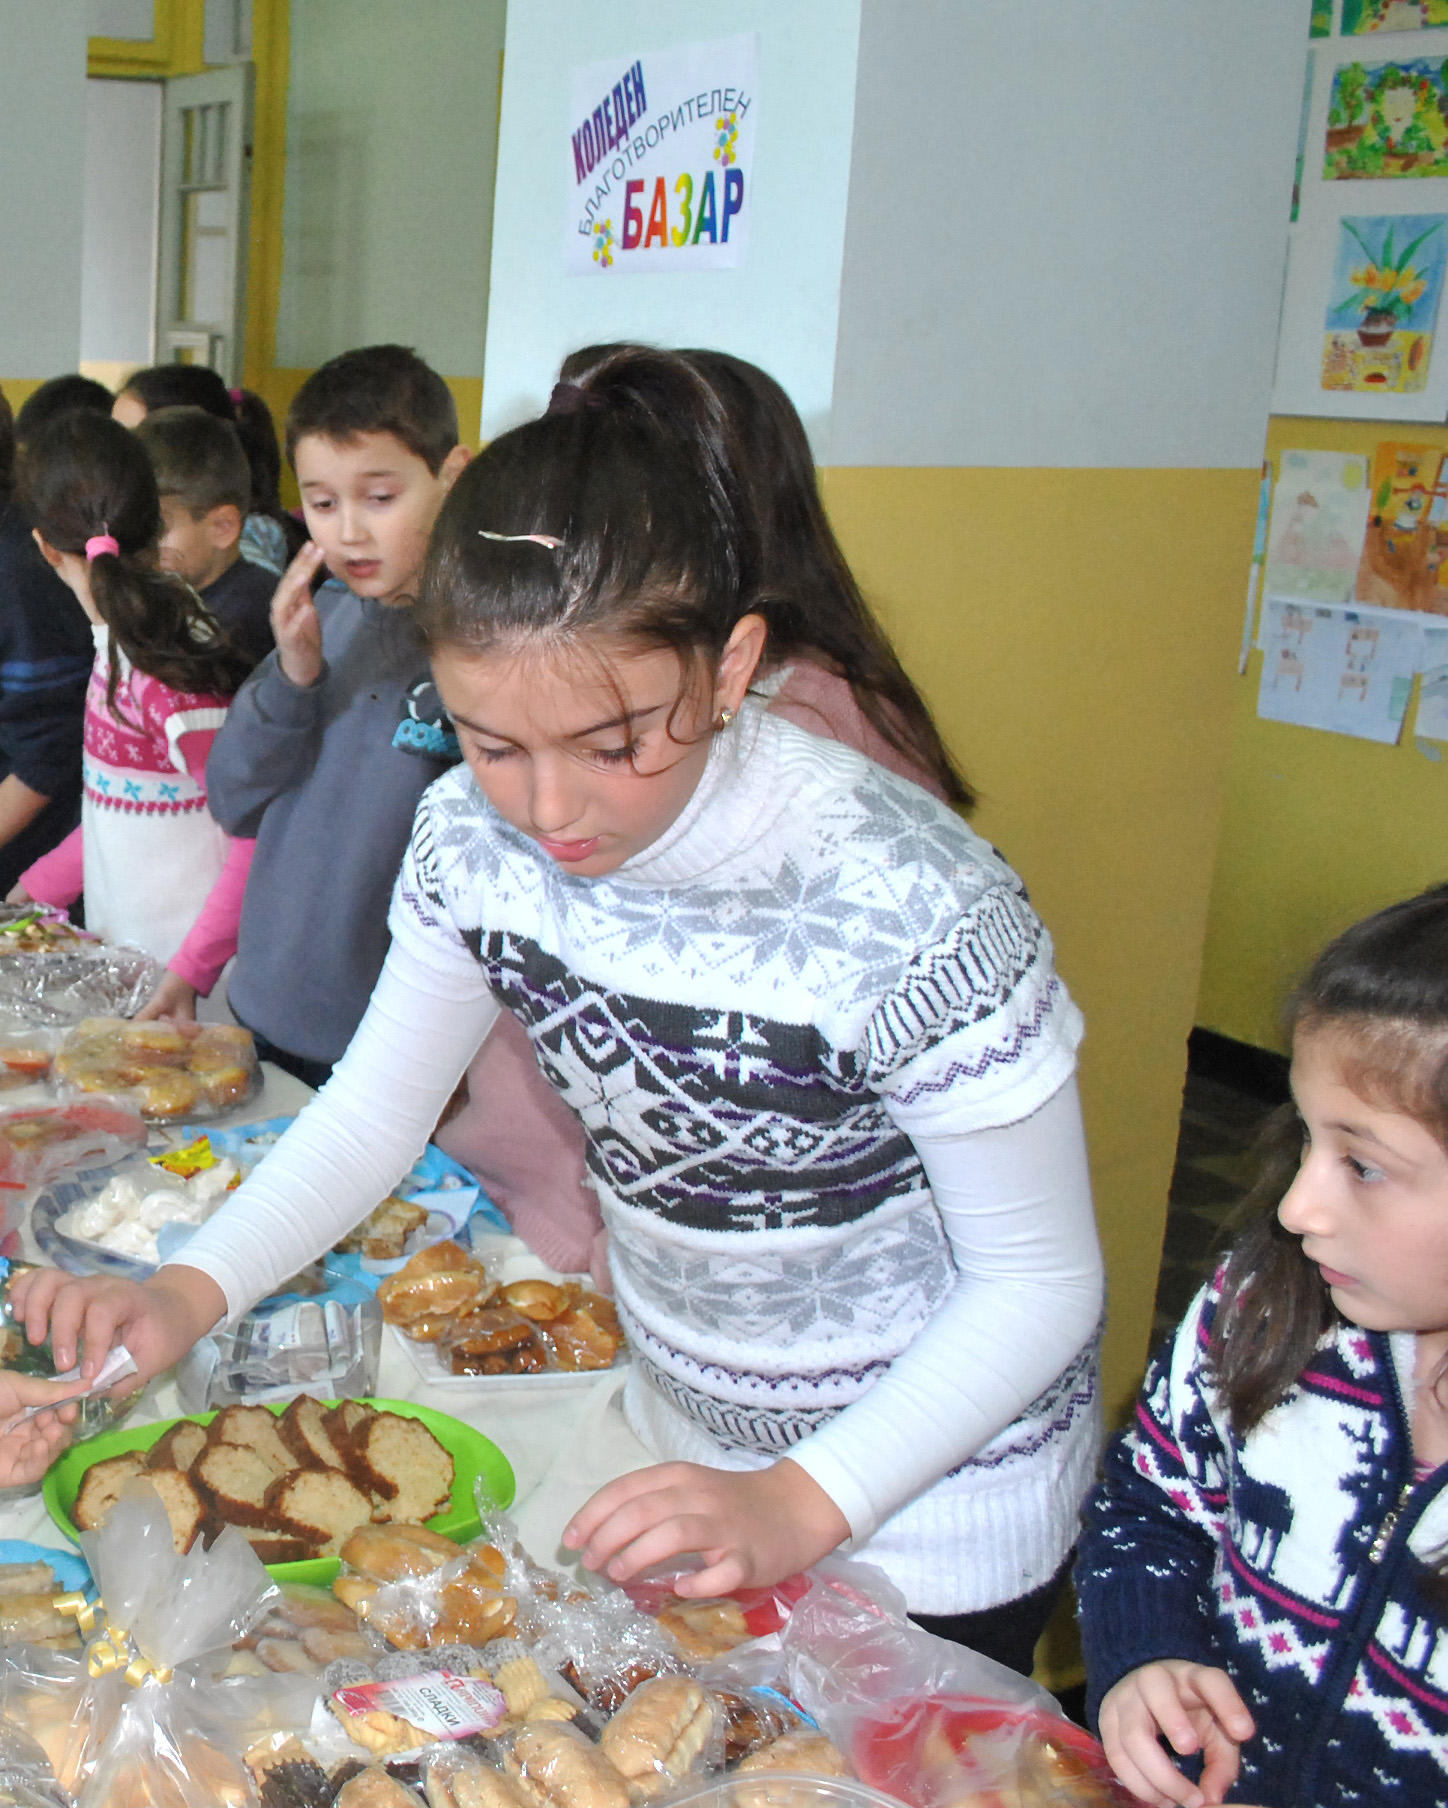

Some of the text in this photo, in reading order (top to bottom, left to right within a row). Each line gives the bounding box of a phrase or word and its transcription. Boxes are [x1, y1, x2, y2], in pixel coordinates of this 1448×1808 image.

[572, 59, 647, 186] КОЛЕДЕН
[578, 88, 752, 236] БЛАГОТВОРИТЕЛЕН
[622, 167, 745, 250] БАЗАР
[419, 1687, 461, 1727] СЛАДКИ
